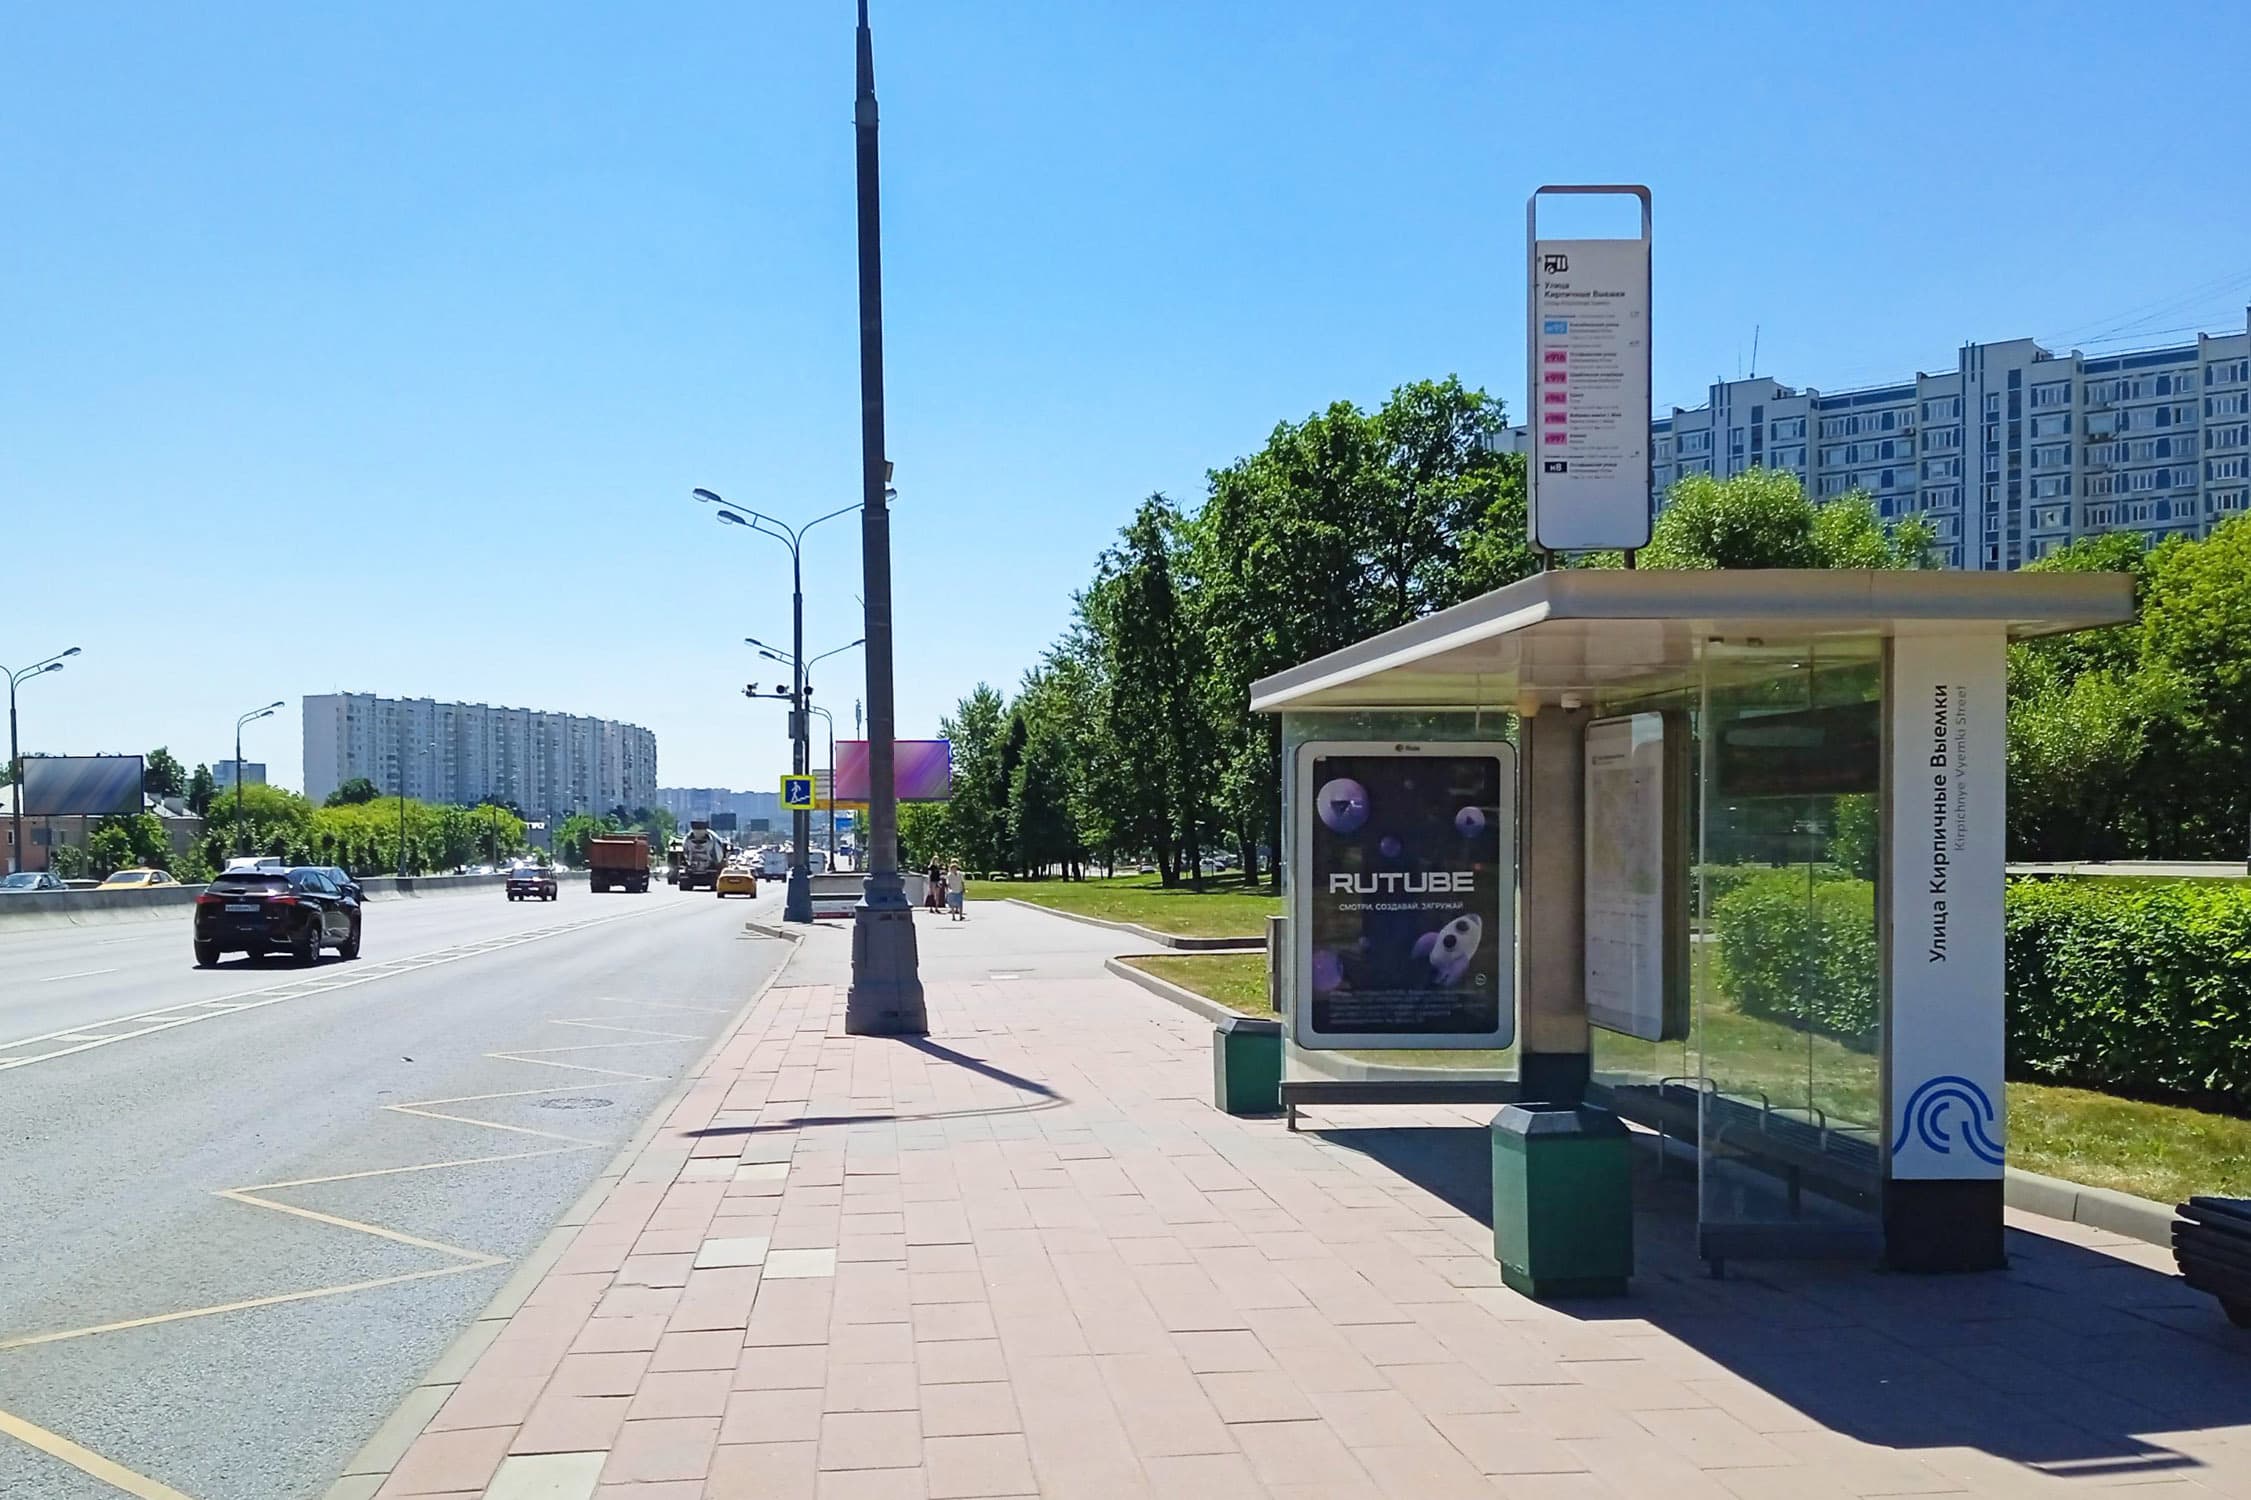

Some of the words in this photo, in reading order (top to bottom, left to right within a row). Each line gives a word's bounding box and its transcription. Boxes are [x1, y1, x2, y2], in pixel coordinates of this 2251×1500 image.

[1930, 685, 1947, 768] Выемки
[1955, 685, 1967, 724] Street
[1955, 729, 1968, 777] Vyemki
[1930, 774, 1950, 894] Кирпичные
[1954, 784, 1968, 851] Kirpichnye
[1329, 871, 1475, 894] RUTUBE
[1929, 901, 1949, 963] Улица
